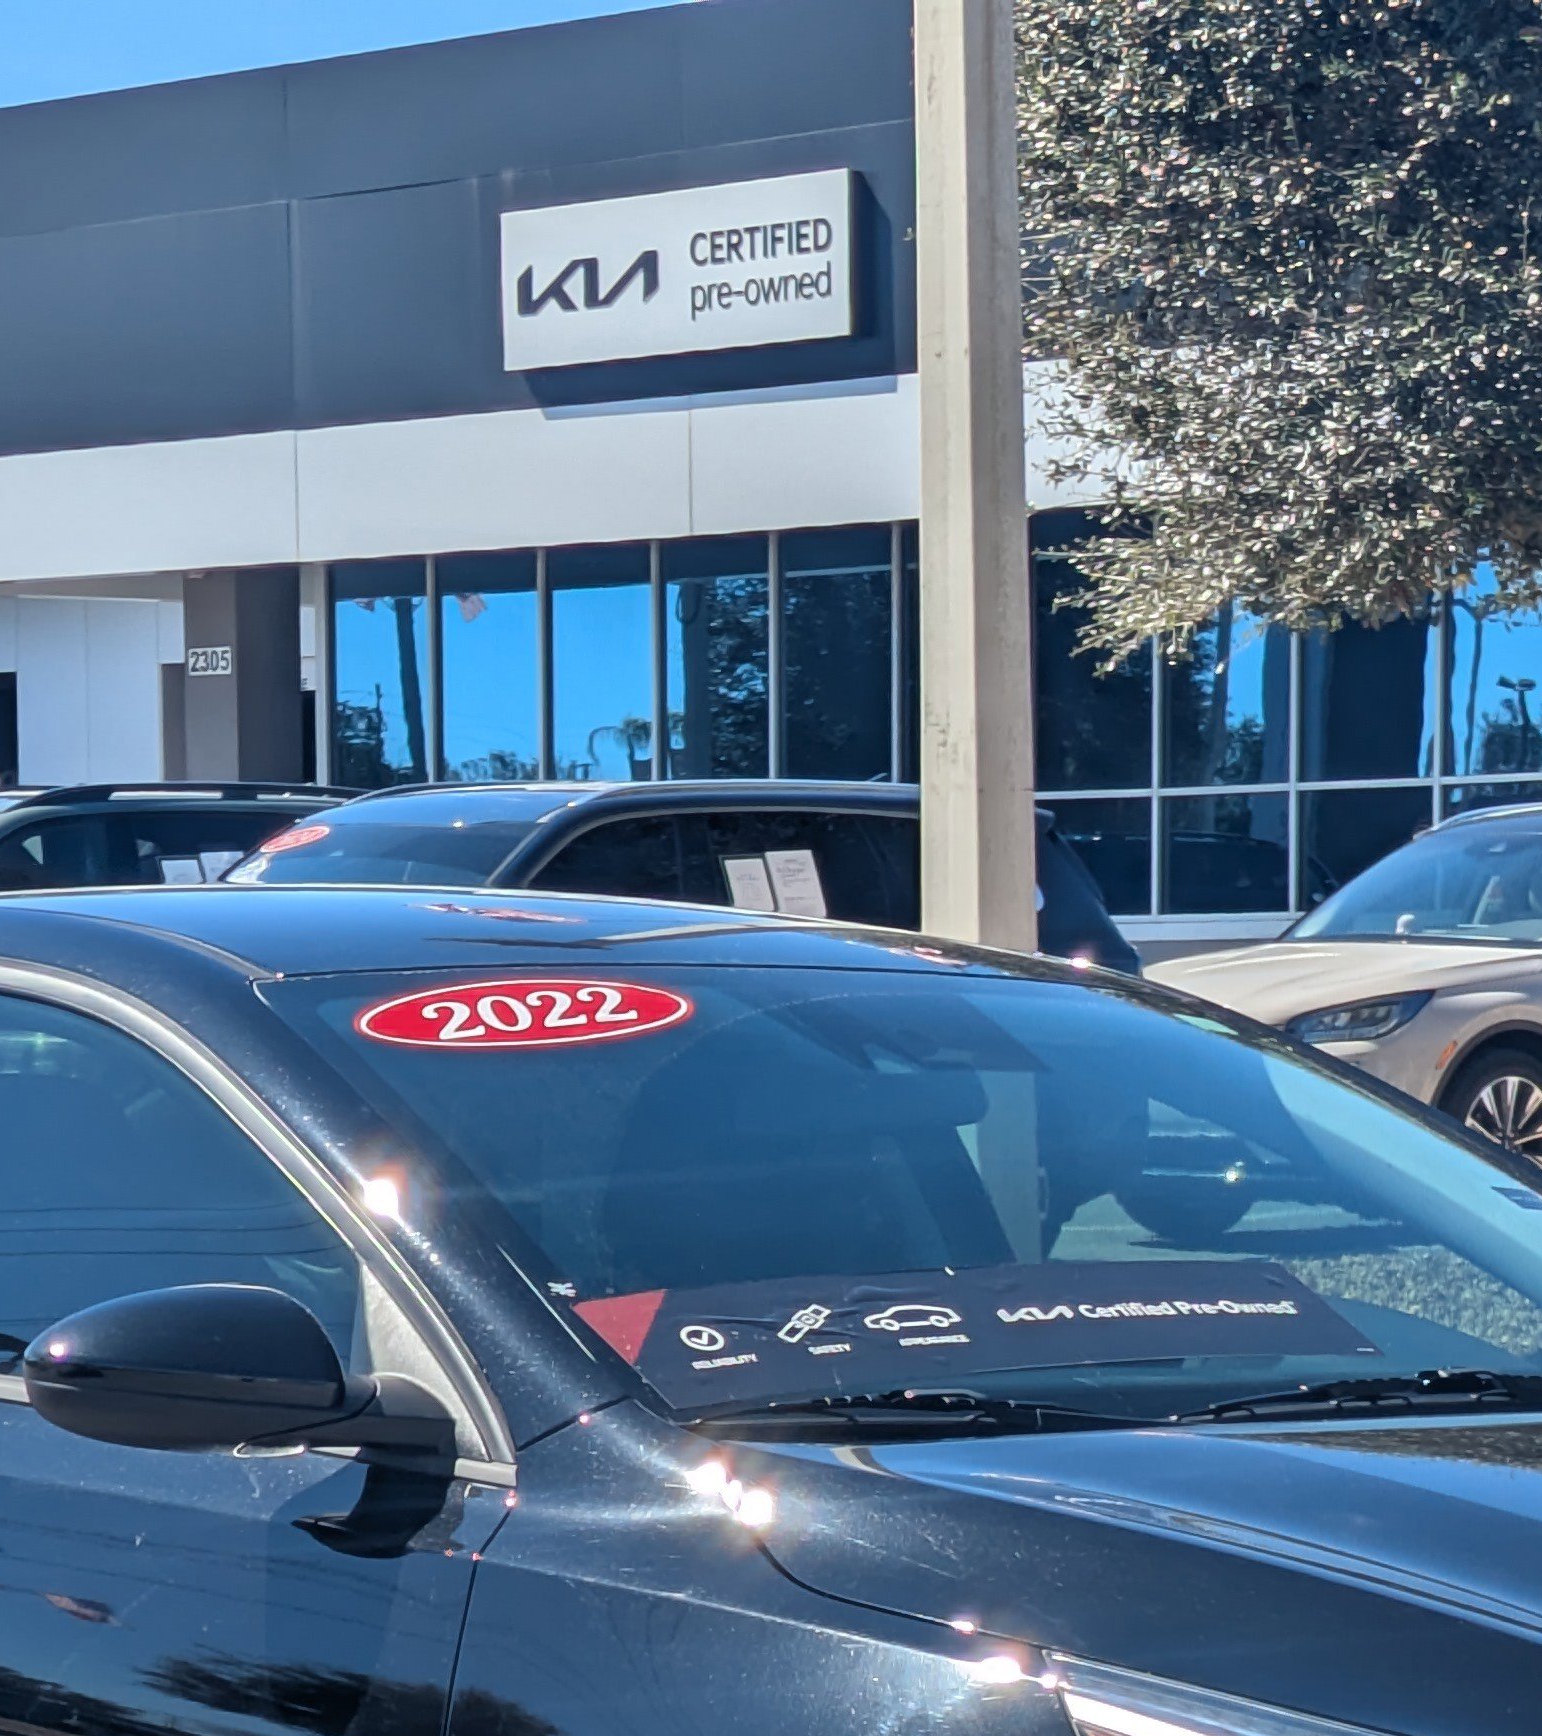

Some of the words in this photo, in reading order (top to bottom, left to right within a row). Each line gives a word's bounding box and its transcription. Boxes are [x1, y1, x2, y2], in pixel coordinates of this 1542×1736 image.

[690, 217, 833, 266] CERTIFIED
[517, 249, 660, 317] KIA
[690, 261, 833, 321] pre-owned
[190, 650, 230, 673] 2305
[421, 986, 640, 1041] 2022
[996, 1303, 1075, 1323] KIA
[1077, 1300, 1178, 1319] Certified
